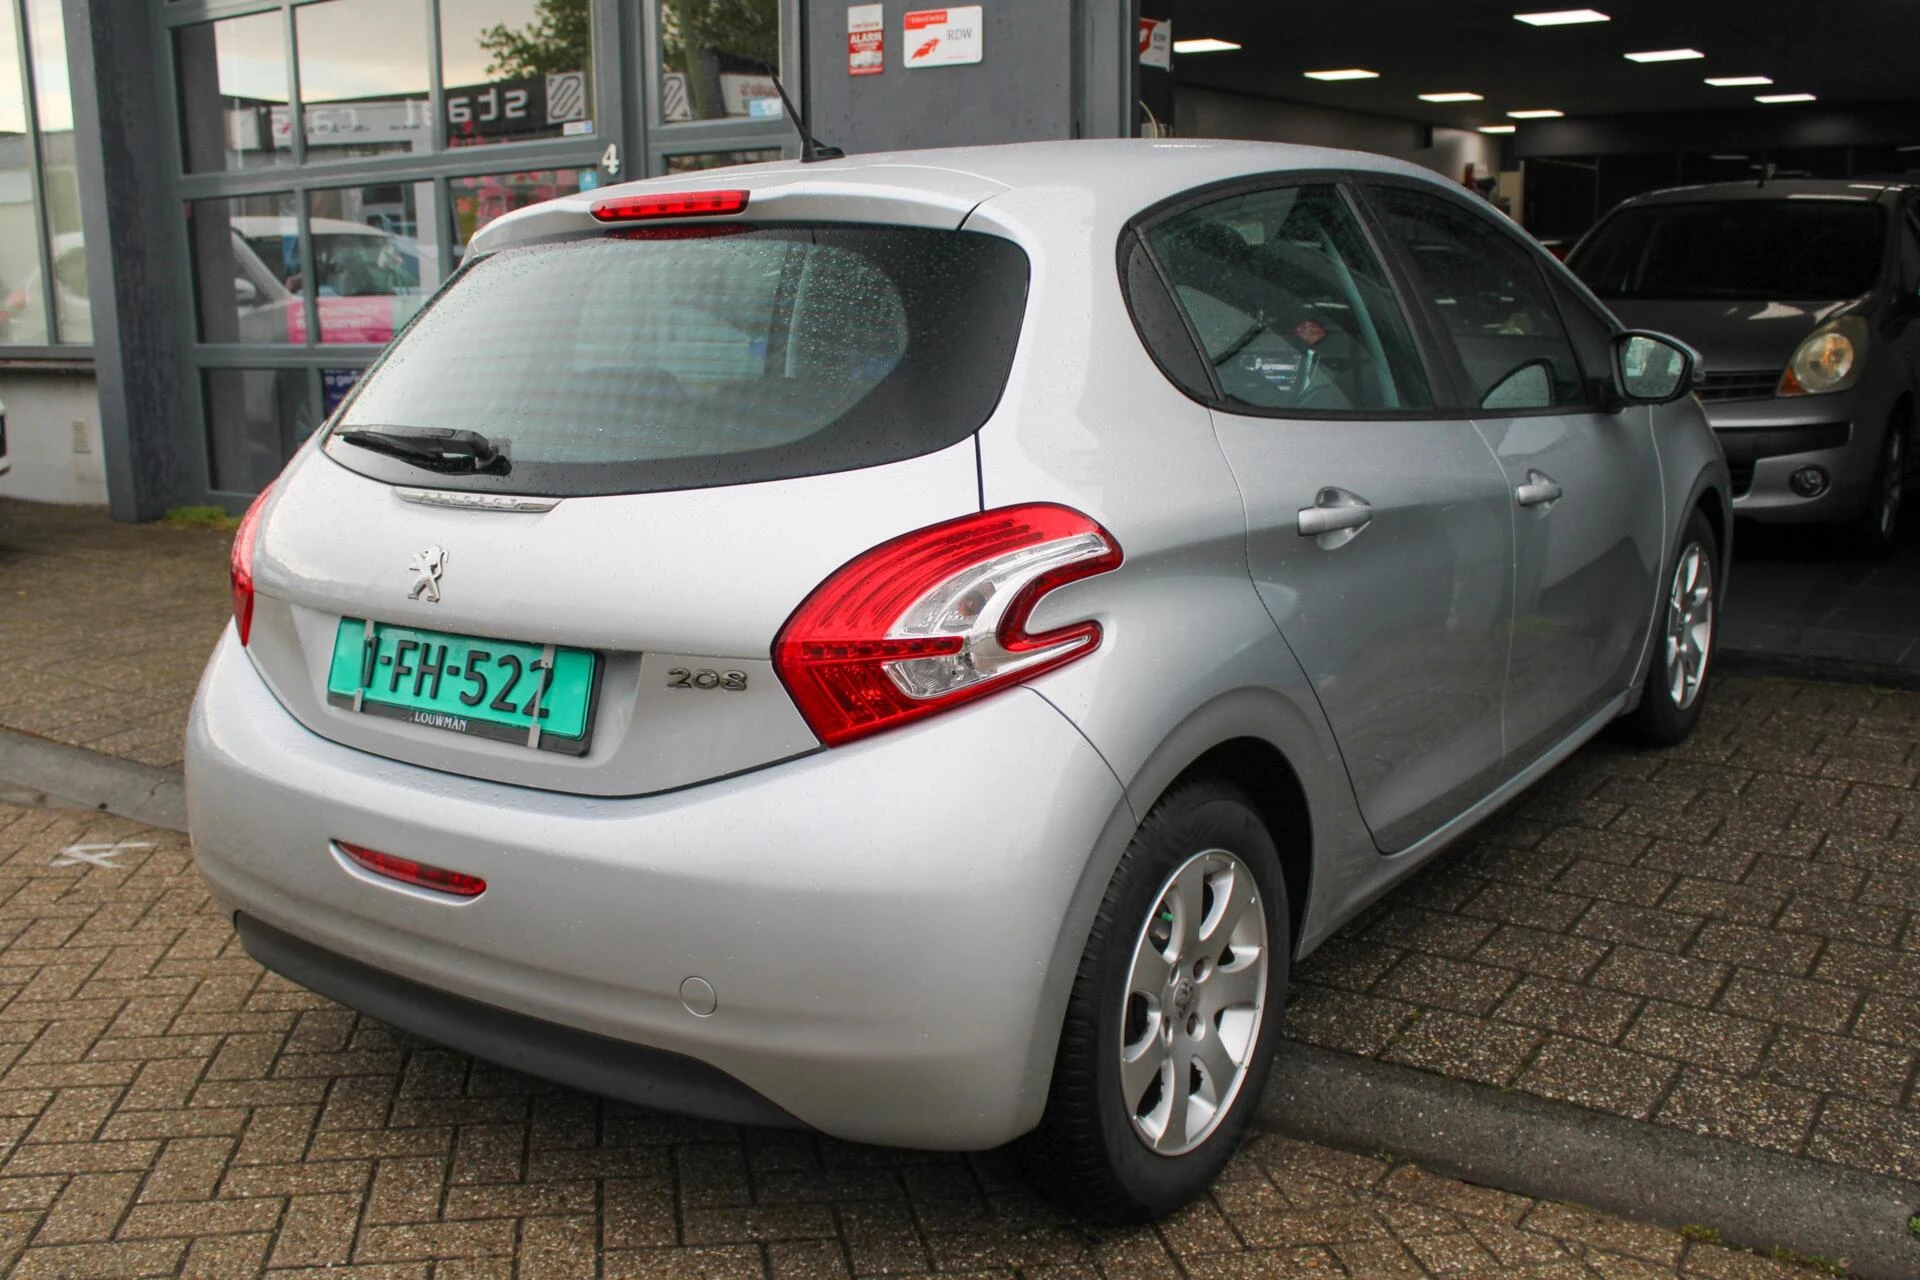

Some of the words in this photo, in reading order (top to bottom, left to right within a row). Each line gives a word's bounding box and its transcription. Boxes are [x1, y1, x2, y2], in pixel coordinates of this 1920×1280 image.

[850, 32, 882, 44] ALARM
[946, 28, 973, 41] RDW
[602, 143, 620, 175] 4
[667, 667, 748, 691] 208
[414, 710, 467, 731] LOUWMAN
